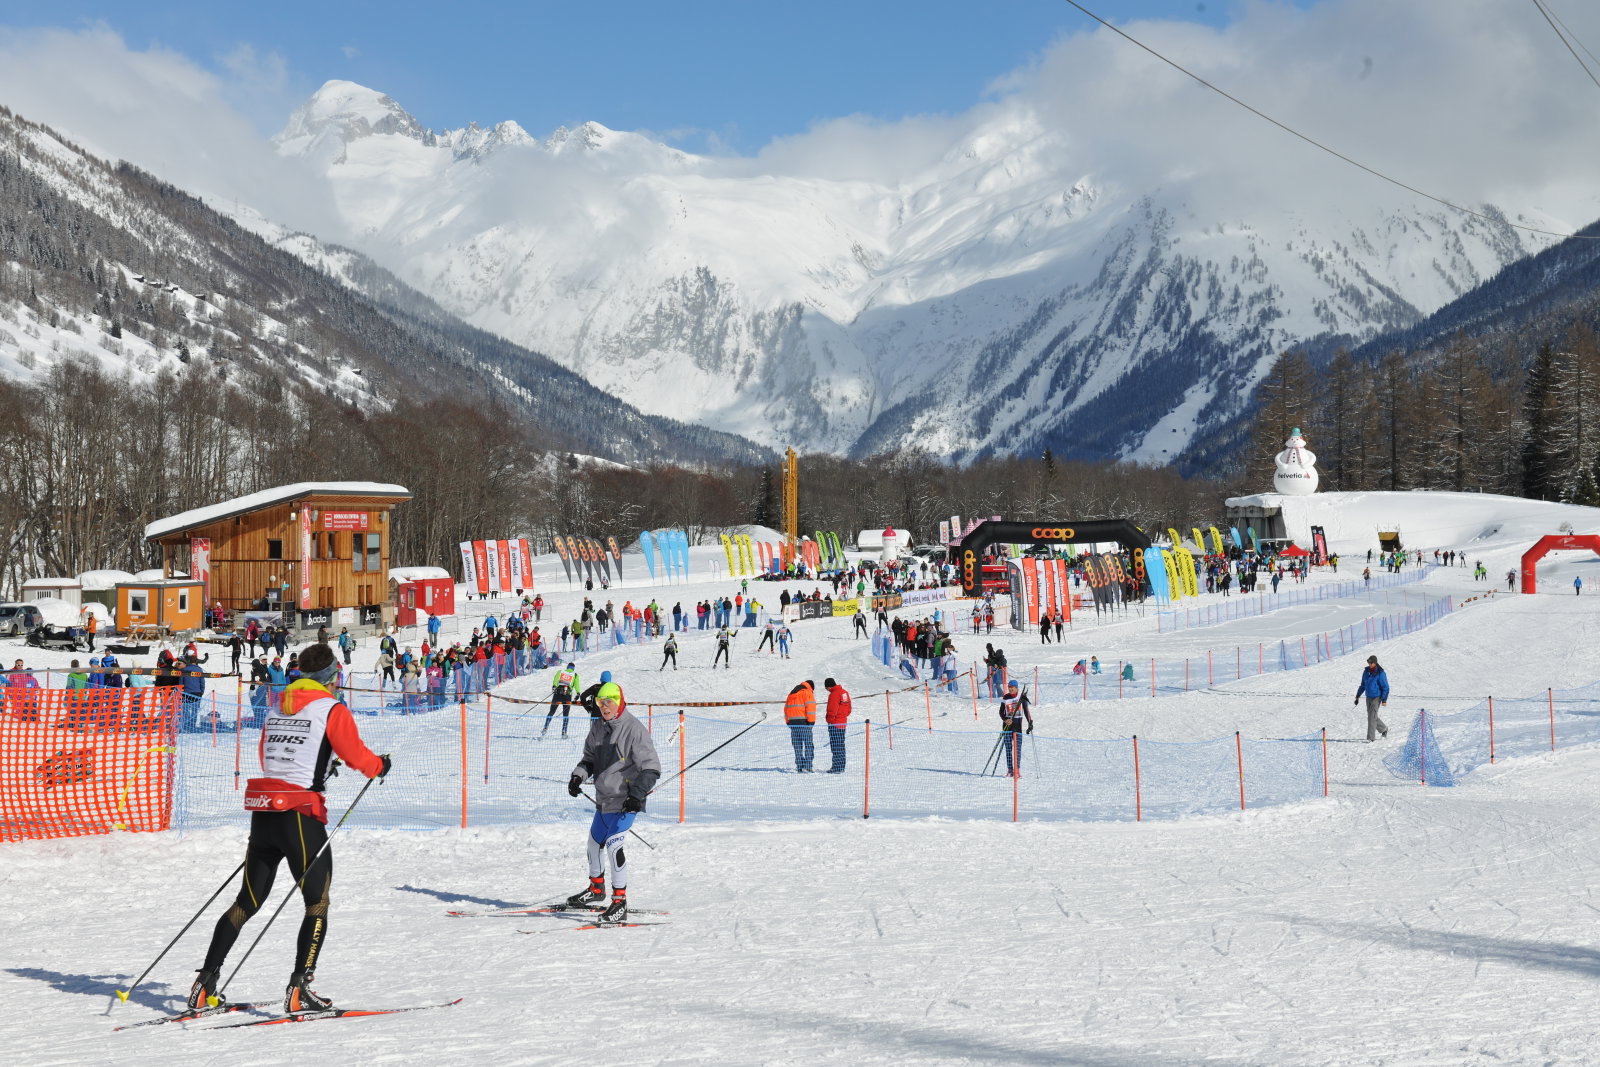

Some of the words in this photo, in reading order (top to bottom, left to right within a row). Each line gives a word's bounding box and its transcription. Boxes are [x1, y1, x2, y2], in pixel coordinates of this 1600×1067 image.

[1031, 528, 1075, 542] coop
[964, 549, 976, 591] coop
[1134, 547, 1145, 580] oop
[313, 918, 323, 942] HELLY
